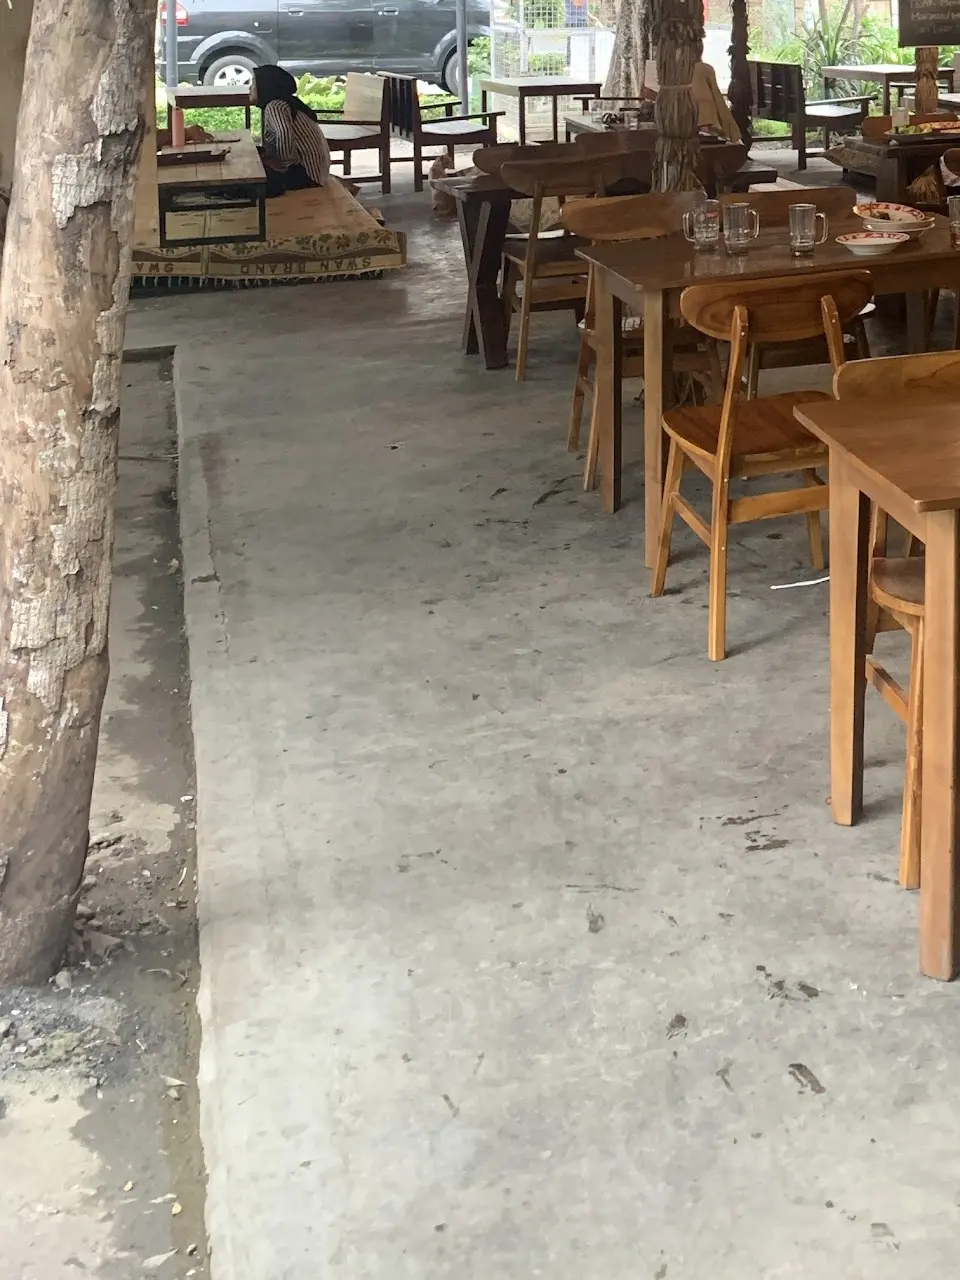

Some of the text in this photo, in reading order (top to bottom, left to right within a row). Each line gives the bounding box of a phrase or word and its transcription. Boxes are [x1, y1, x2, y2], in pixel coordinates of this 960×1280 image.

[135, 262, 175, 273] SWA
[239, 256, 372, 276] SWAN BRAND
